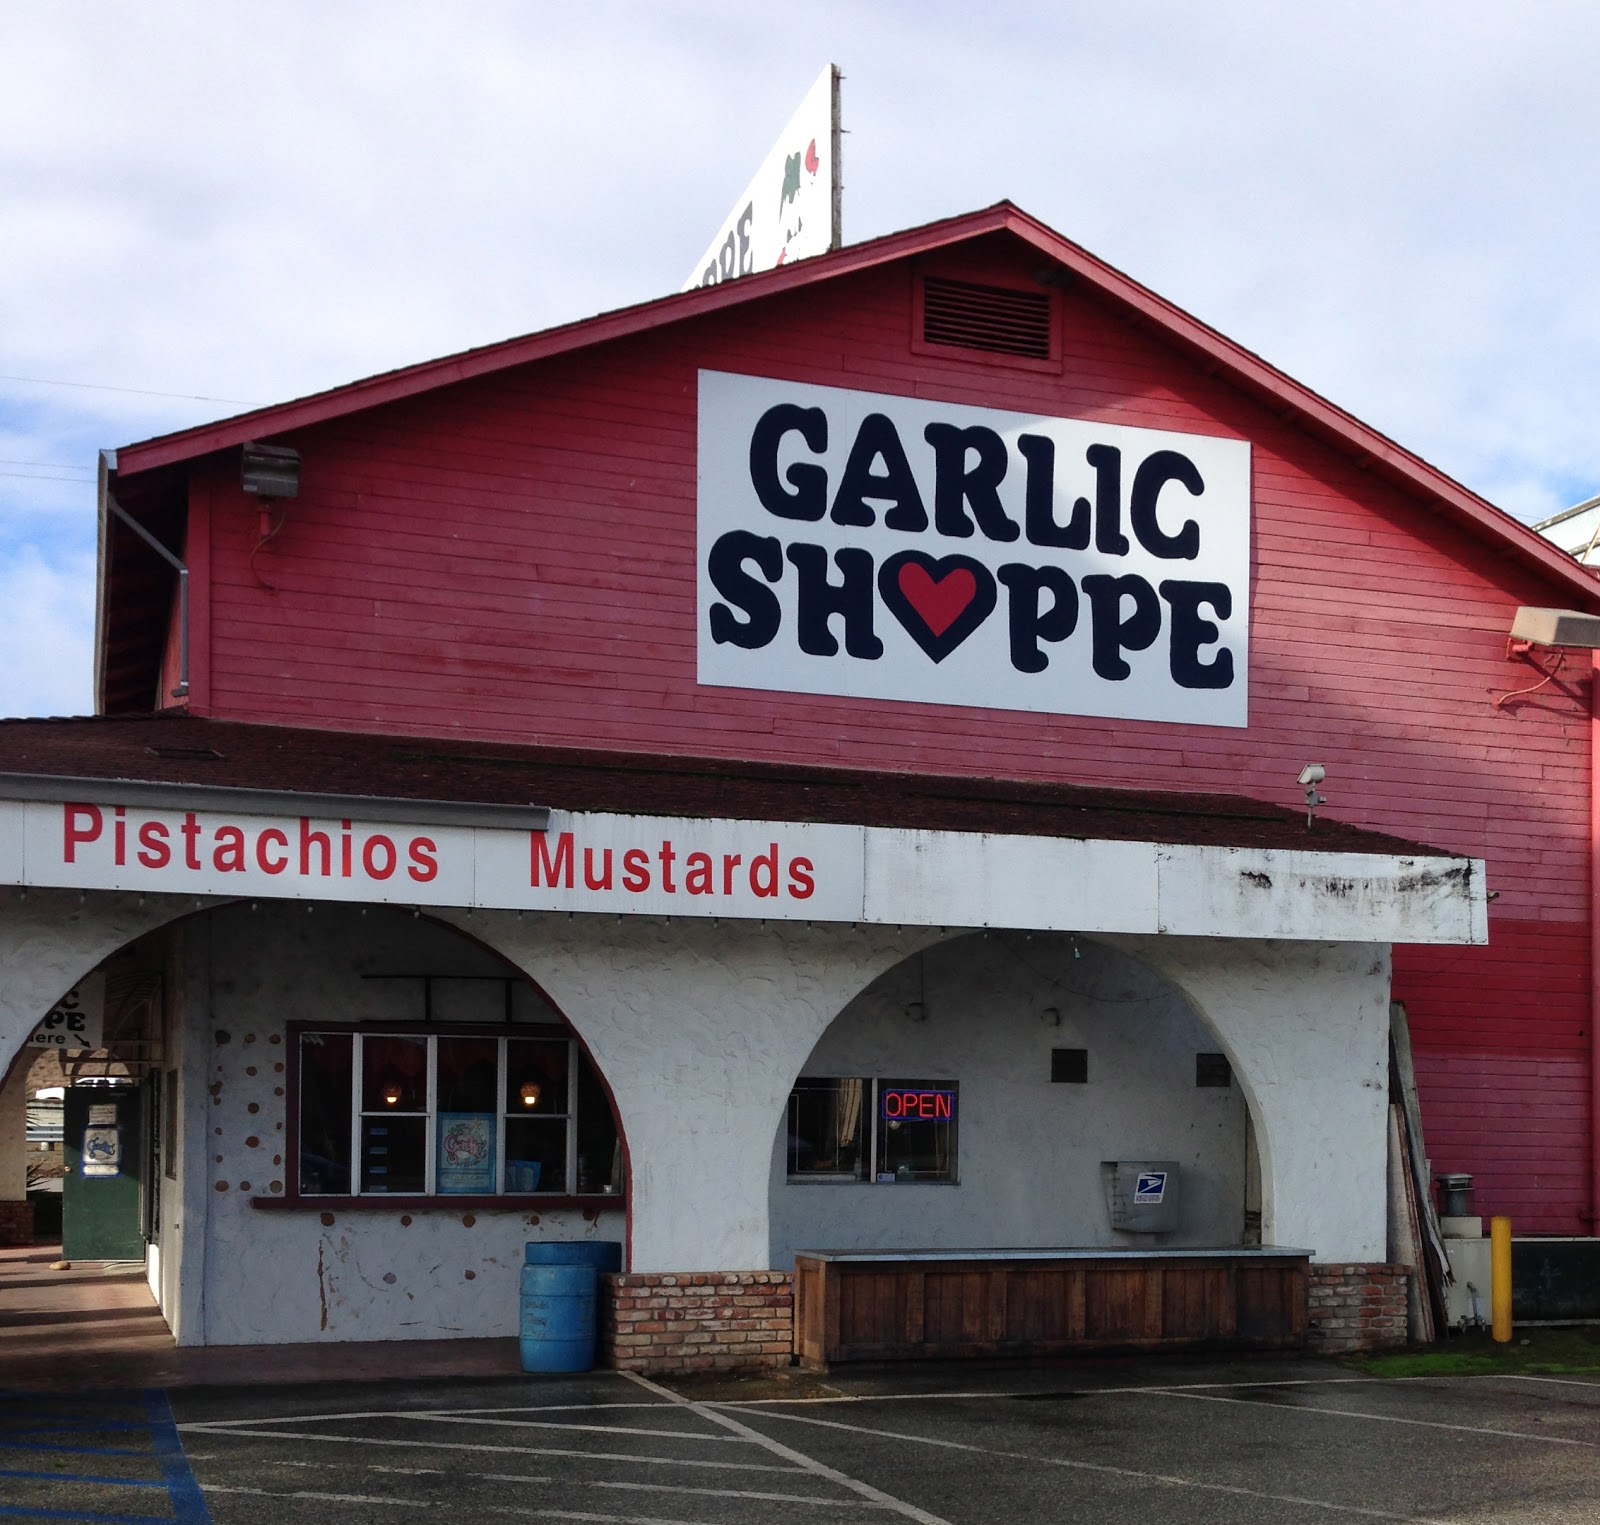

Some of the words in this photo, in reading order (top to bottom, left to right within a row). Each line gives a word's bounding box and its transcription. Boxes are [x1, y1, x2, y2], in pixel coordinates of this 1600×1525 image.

[749, 403, 1205, 560] GARLIC
[708, 529, 1235, 689] SHOPPE
[65, 803, 437, 882] Pistachios
[531, 830, 815, 900] Mustards
[885, 1092, 951, 1118] OPEN
